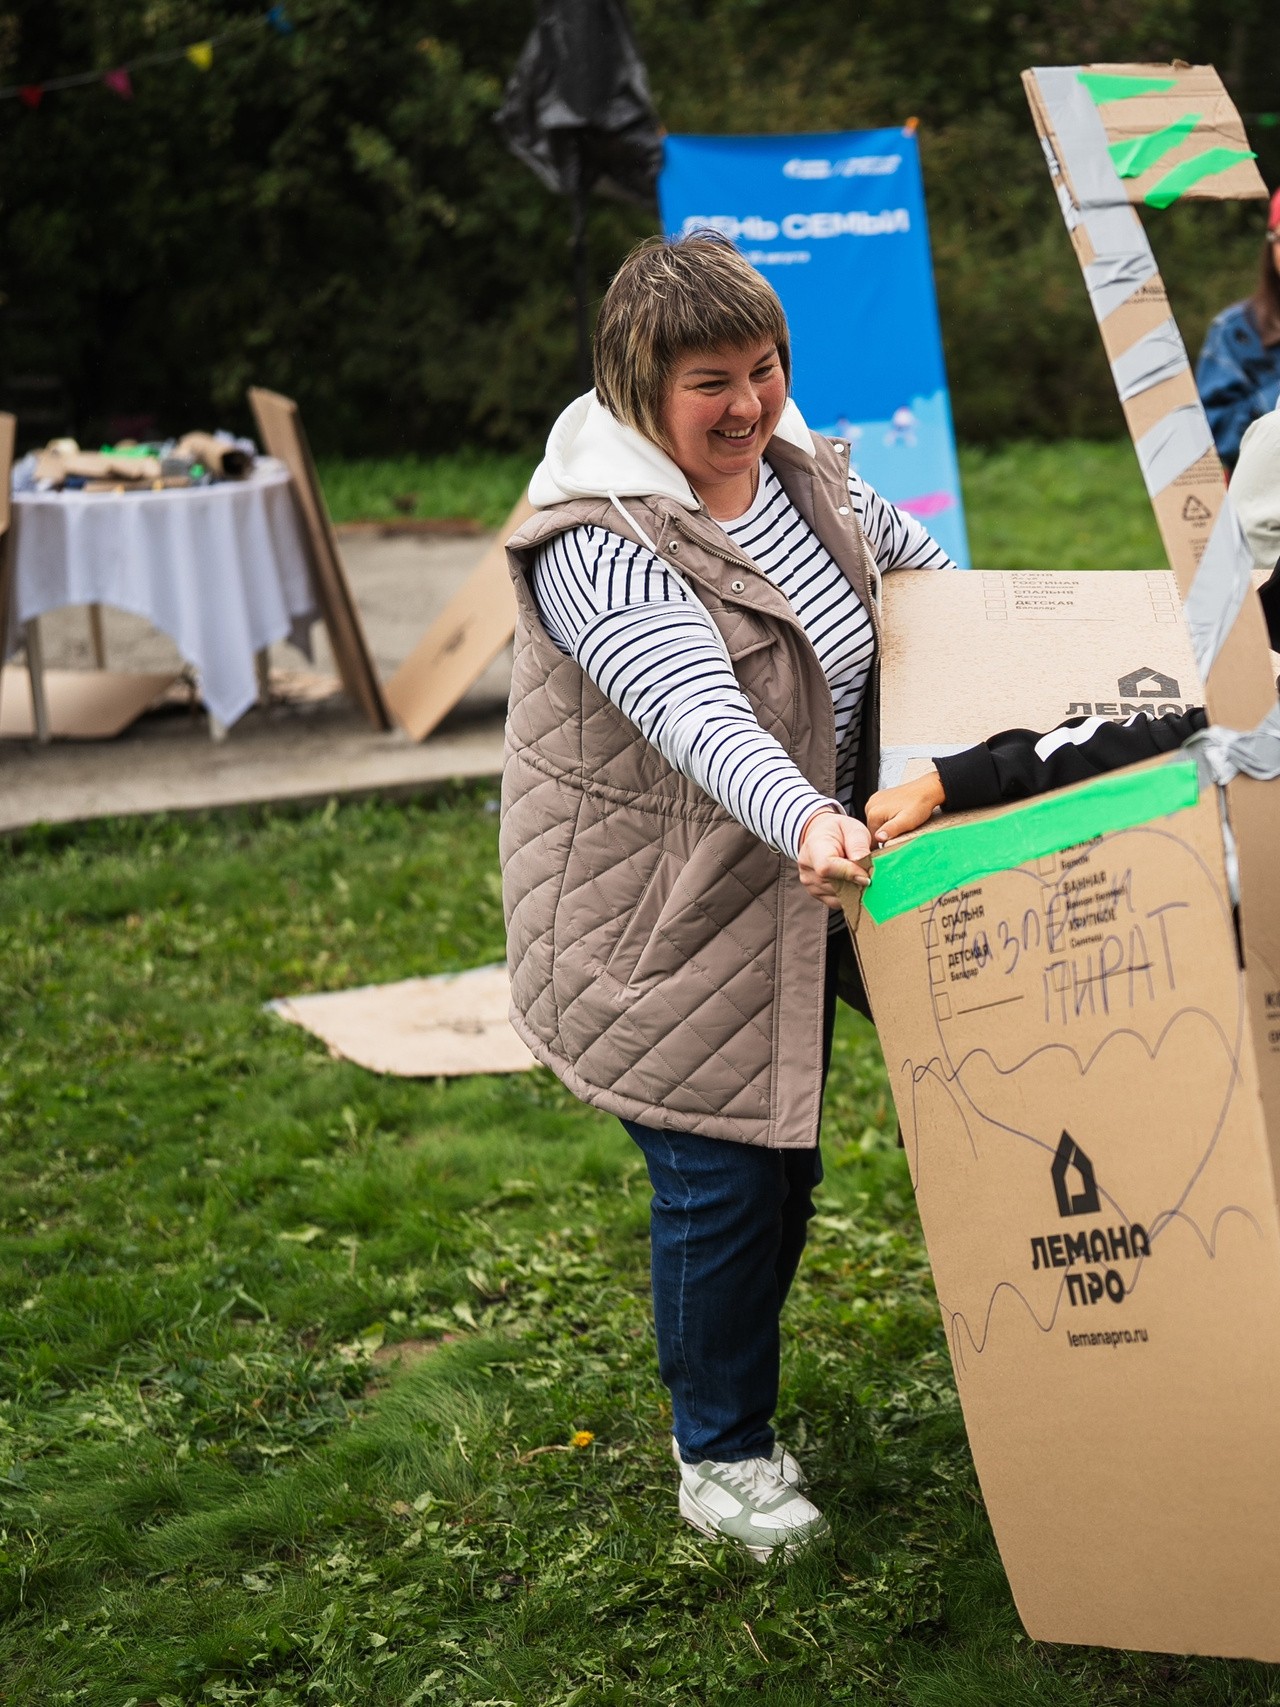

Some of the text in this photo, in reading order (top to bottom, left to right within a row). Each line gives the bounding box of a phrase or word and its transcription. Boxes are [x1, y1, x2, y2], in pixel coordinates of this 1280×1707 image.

[942, 905, 985, 929] СПАЛЬНЯ
[948, 943, 989, 969] ДЕТСКАЯ
[1043, 901, 1190, 1026] ПИРАТ
[1030, 1222, 1152, 1271] ЛЕМАНА
[1065, 1268, 1125, 1307] ПРО
[1066, 1328, 1149, 1349] lemanapro.ru
